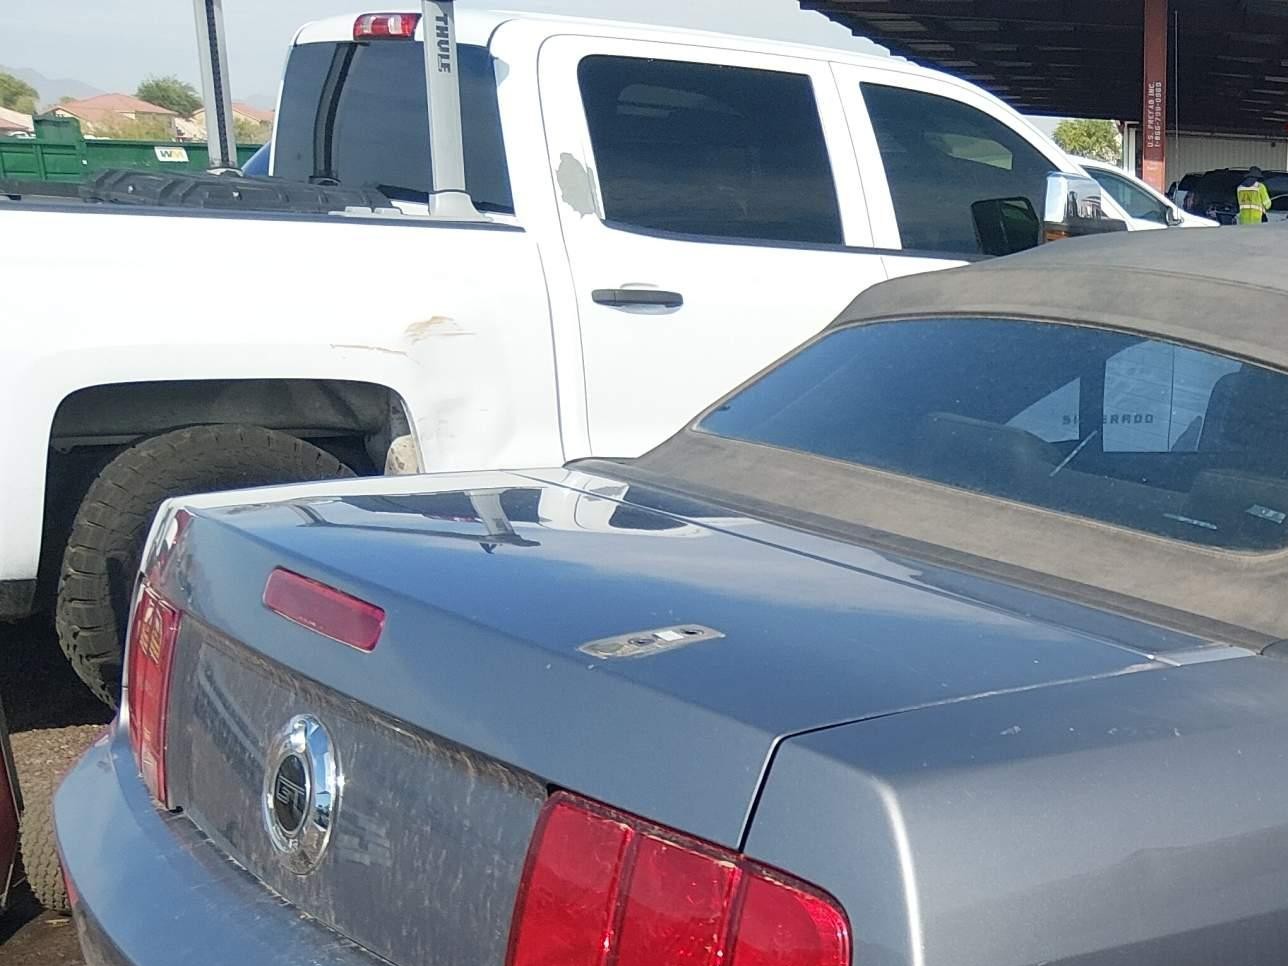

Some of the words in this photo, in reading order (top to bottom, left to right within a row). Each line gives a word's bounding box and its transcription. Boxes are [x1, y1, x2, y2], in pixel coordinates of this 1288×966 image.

[435, 14, 451, 73] THULE
[1062, 414, 1155, 425] SIERADO
[276, 775, 305, 808] GT
